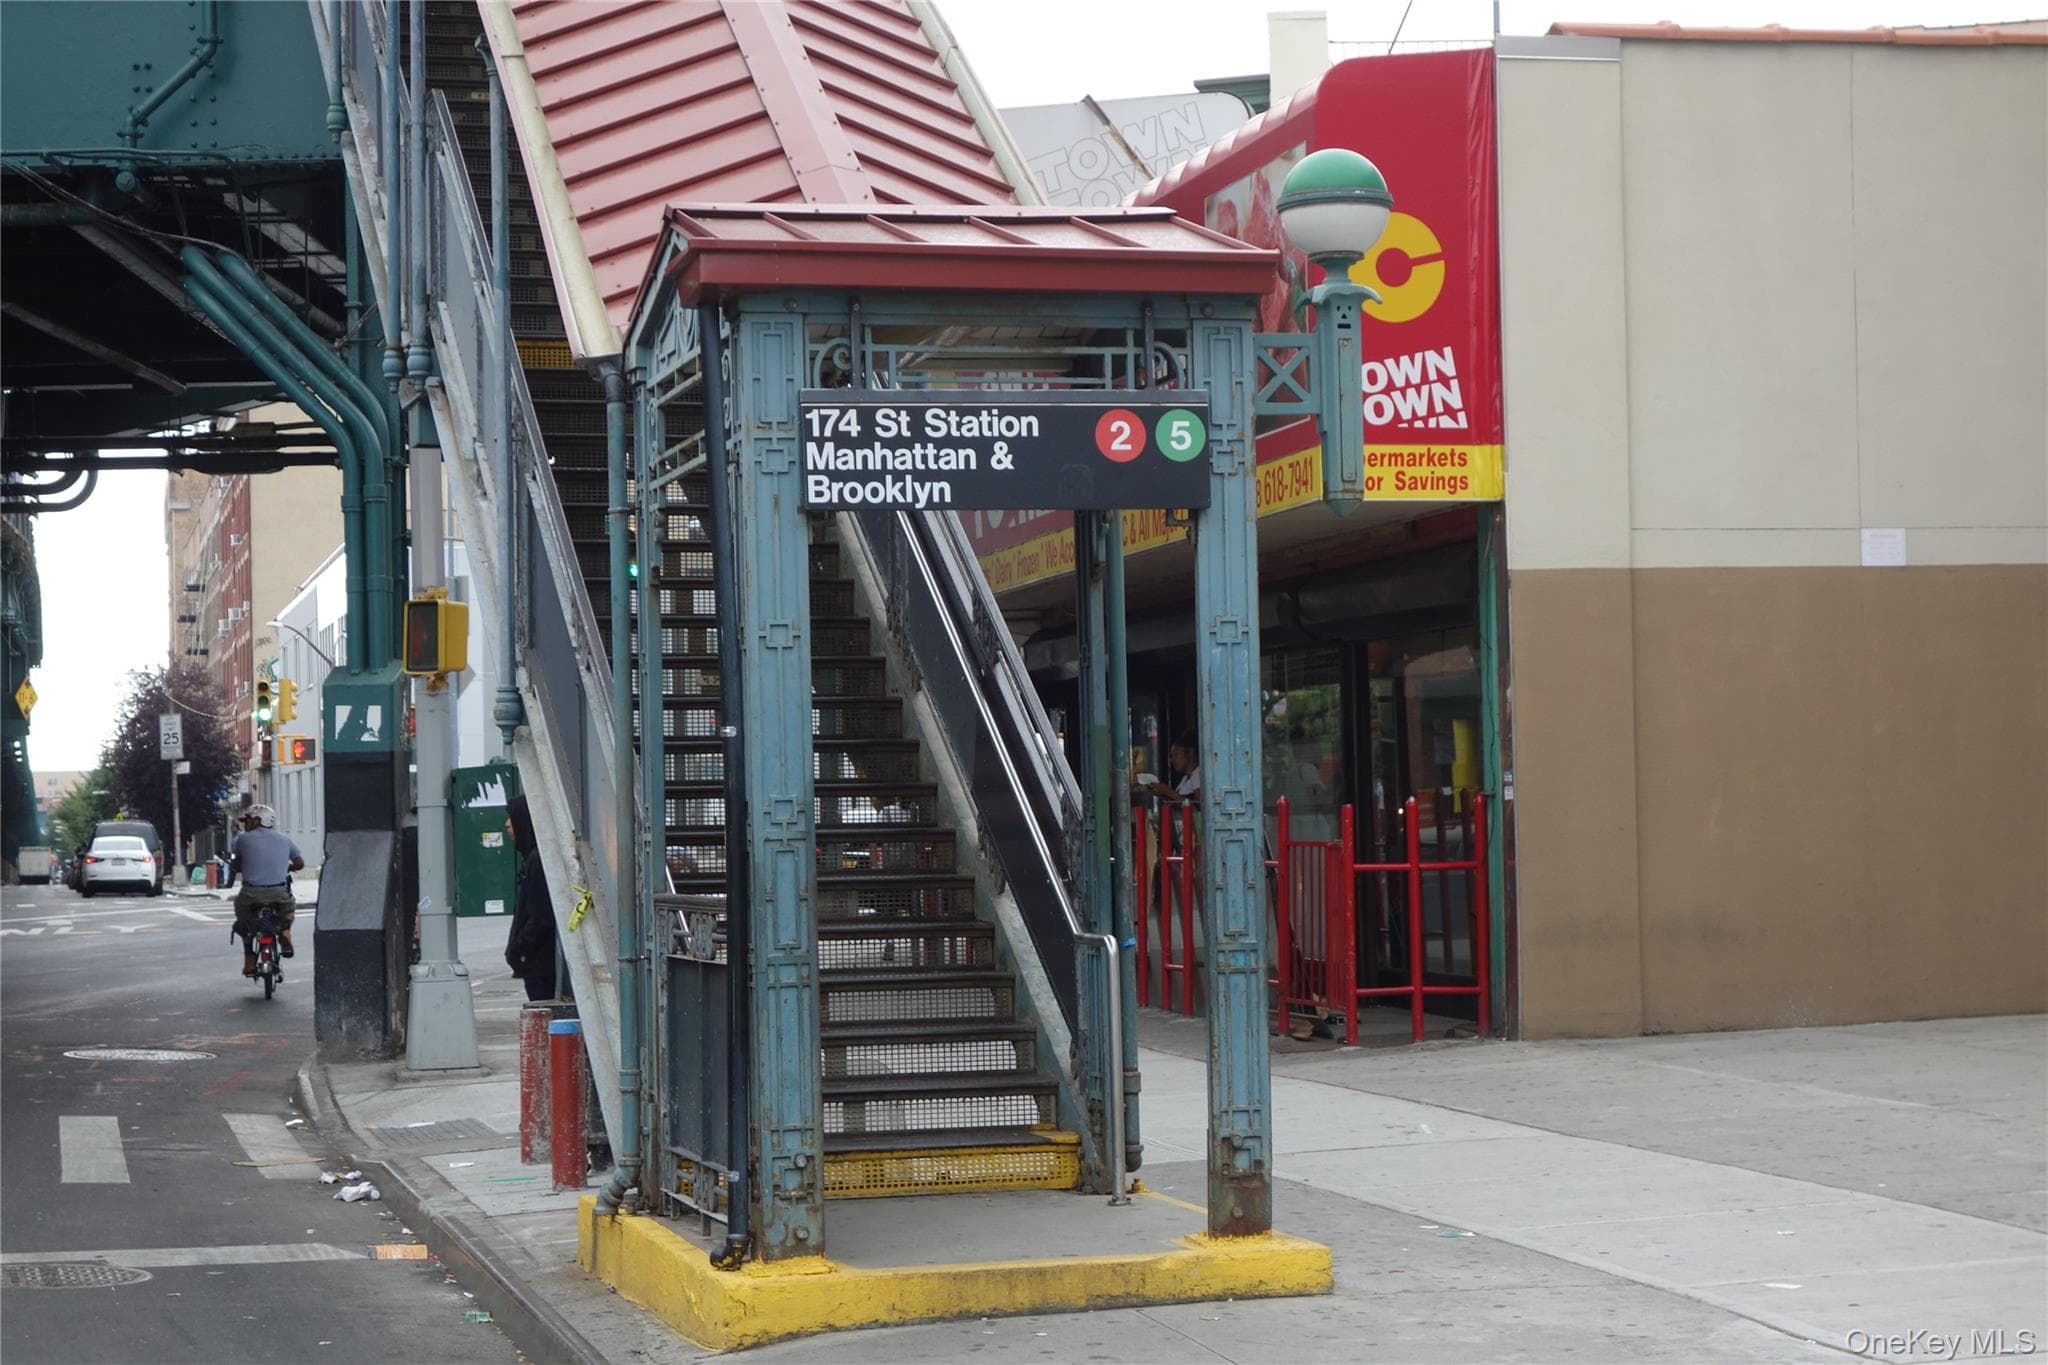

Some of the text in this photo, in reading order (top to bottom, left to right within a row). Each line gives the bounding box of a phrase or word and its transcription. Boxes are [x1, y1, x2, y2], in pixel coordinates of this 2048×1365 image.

[1027, 100, 1207, 194] TOWN
[805, 408, 1039, 437] 174 St Station
[1110, 420, 1192, 450] 2 5
[806, 441, 1014, 470] Manhattan &
[1363, 447, 1468, 467] ermarkets
[807, 474, 951, 509] Brooklyn
[1264, 456, 1313, 506] 618-7941
[1394, 470, 1469, 495] Savings
[163, 732, 179, 745] 25
